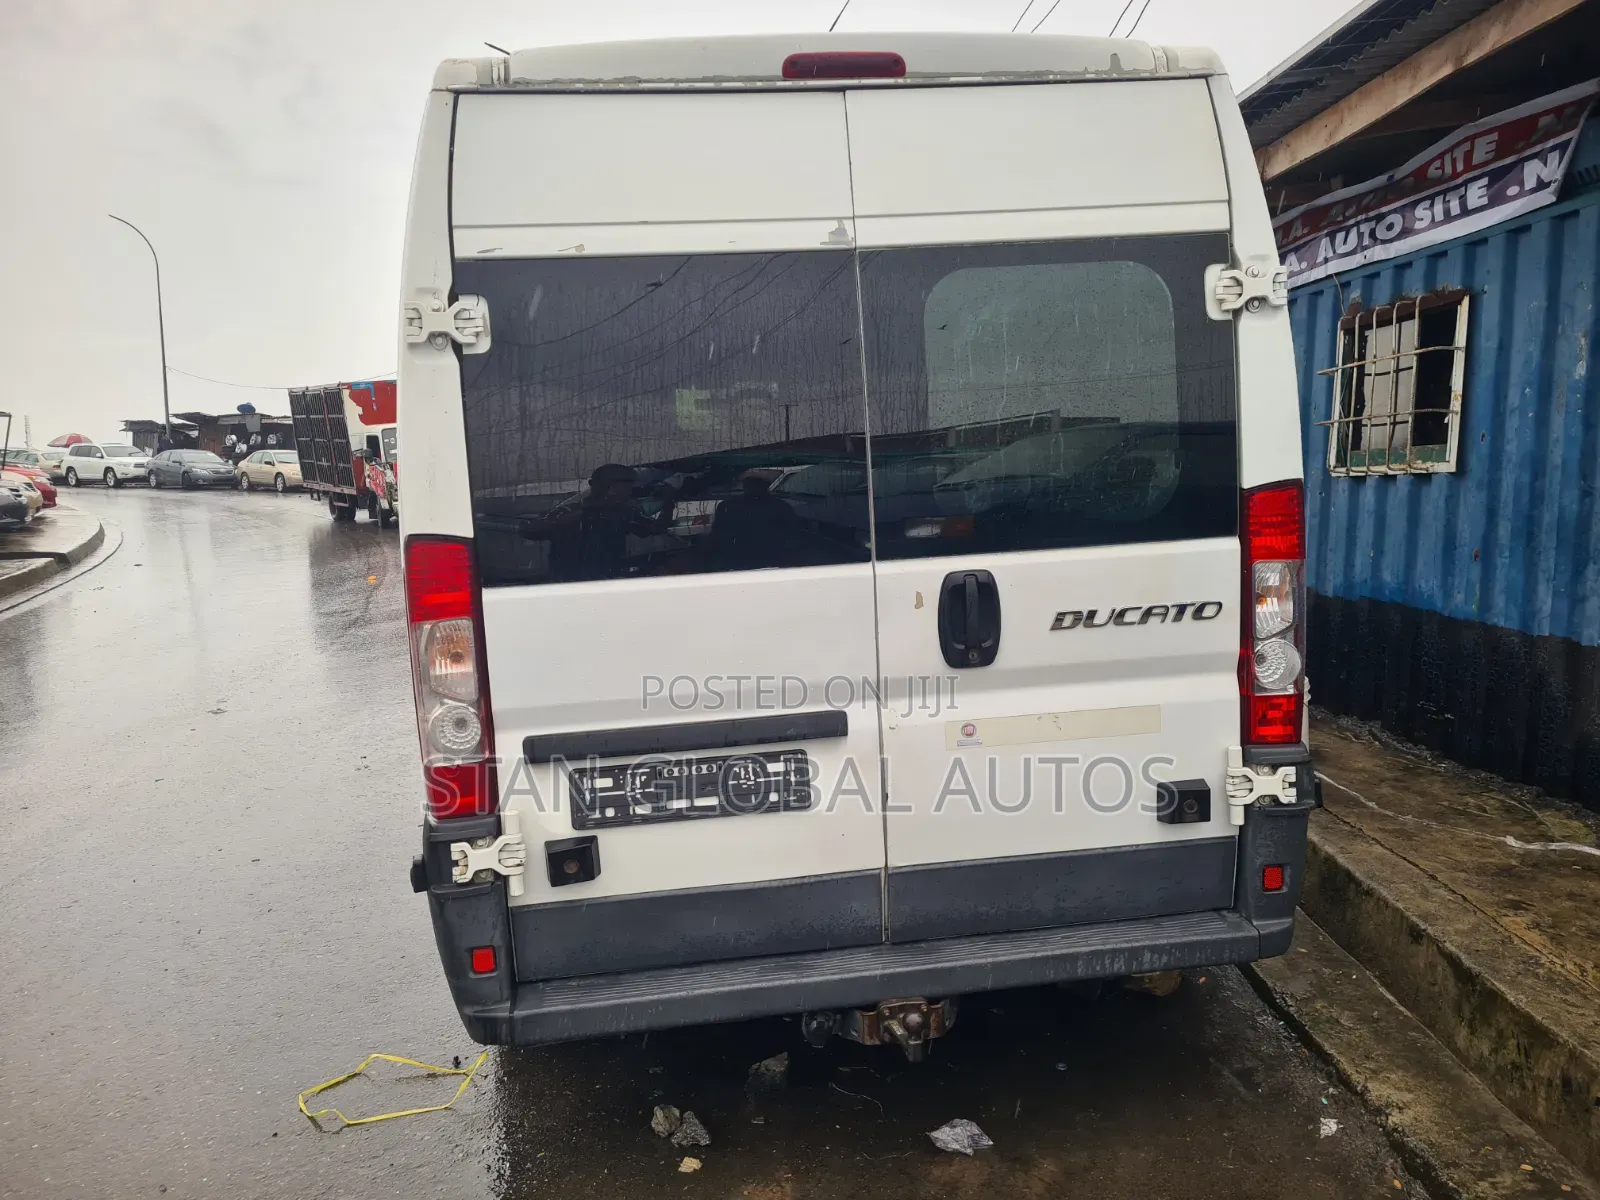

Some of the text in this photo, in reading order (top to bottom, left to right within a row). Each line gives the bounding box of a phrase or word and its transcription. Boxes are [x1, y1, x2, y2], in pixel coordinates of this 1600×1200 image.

[1427, 132, 1499, 180] SITE
[1316, 213, 1404, 264] AUTO
[1413, 176, 1489, 230] SITE
[1049, 601, 1223, 631] DUCATO
